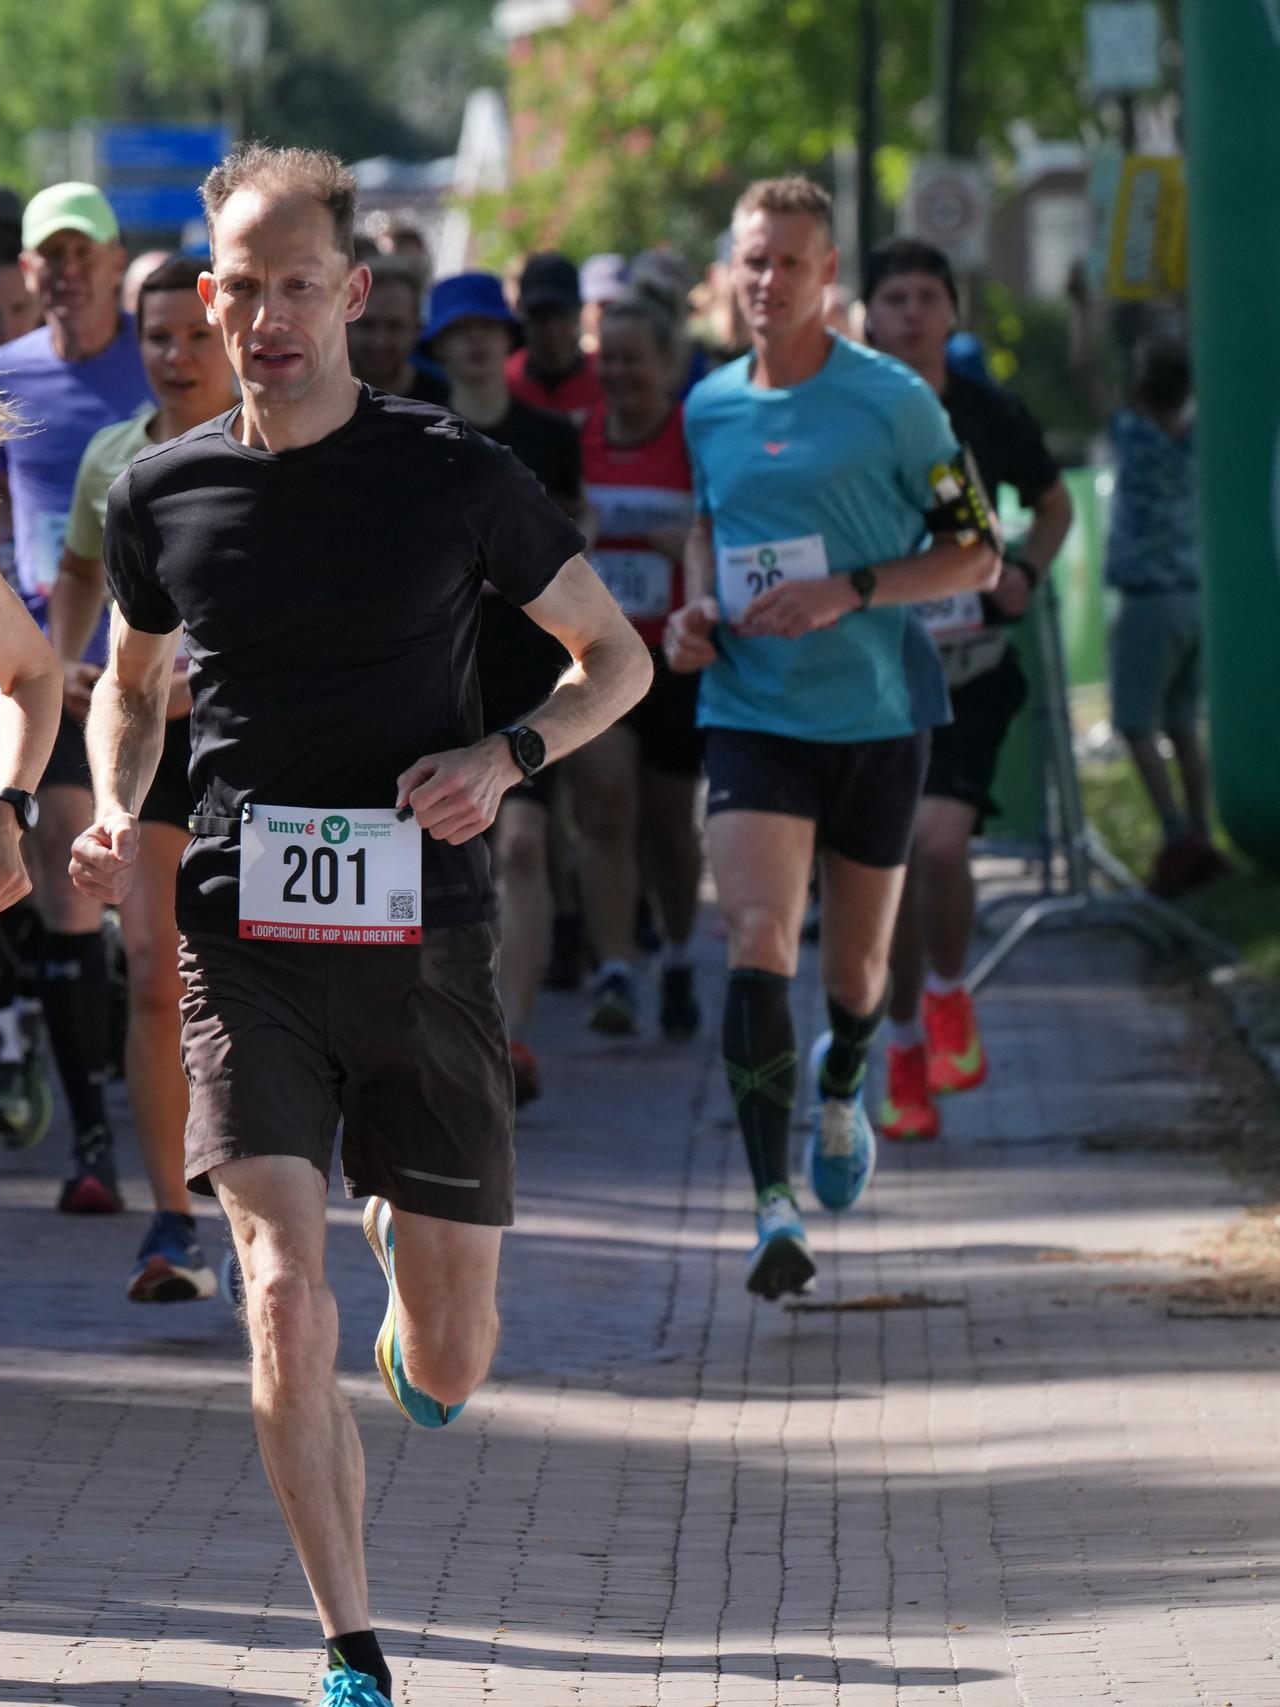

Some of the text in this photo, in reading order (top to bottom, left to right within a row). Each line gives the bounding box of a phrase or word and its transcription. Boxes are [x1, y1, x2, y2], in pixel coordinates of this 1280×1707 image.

[267, 818, 315, 835] univé
[354, 822, 391, 830] Supporter
[370, 829, 391, 838] Sport
[282, 845, 366, 905] 201
[252, 925, 405, 942] LOOPCIRCUIT DE KOP VAN DRENTHE
